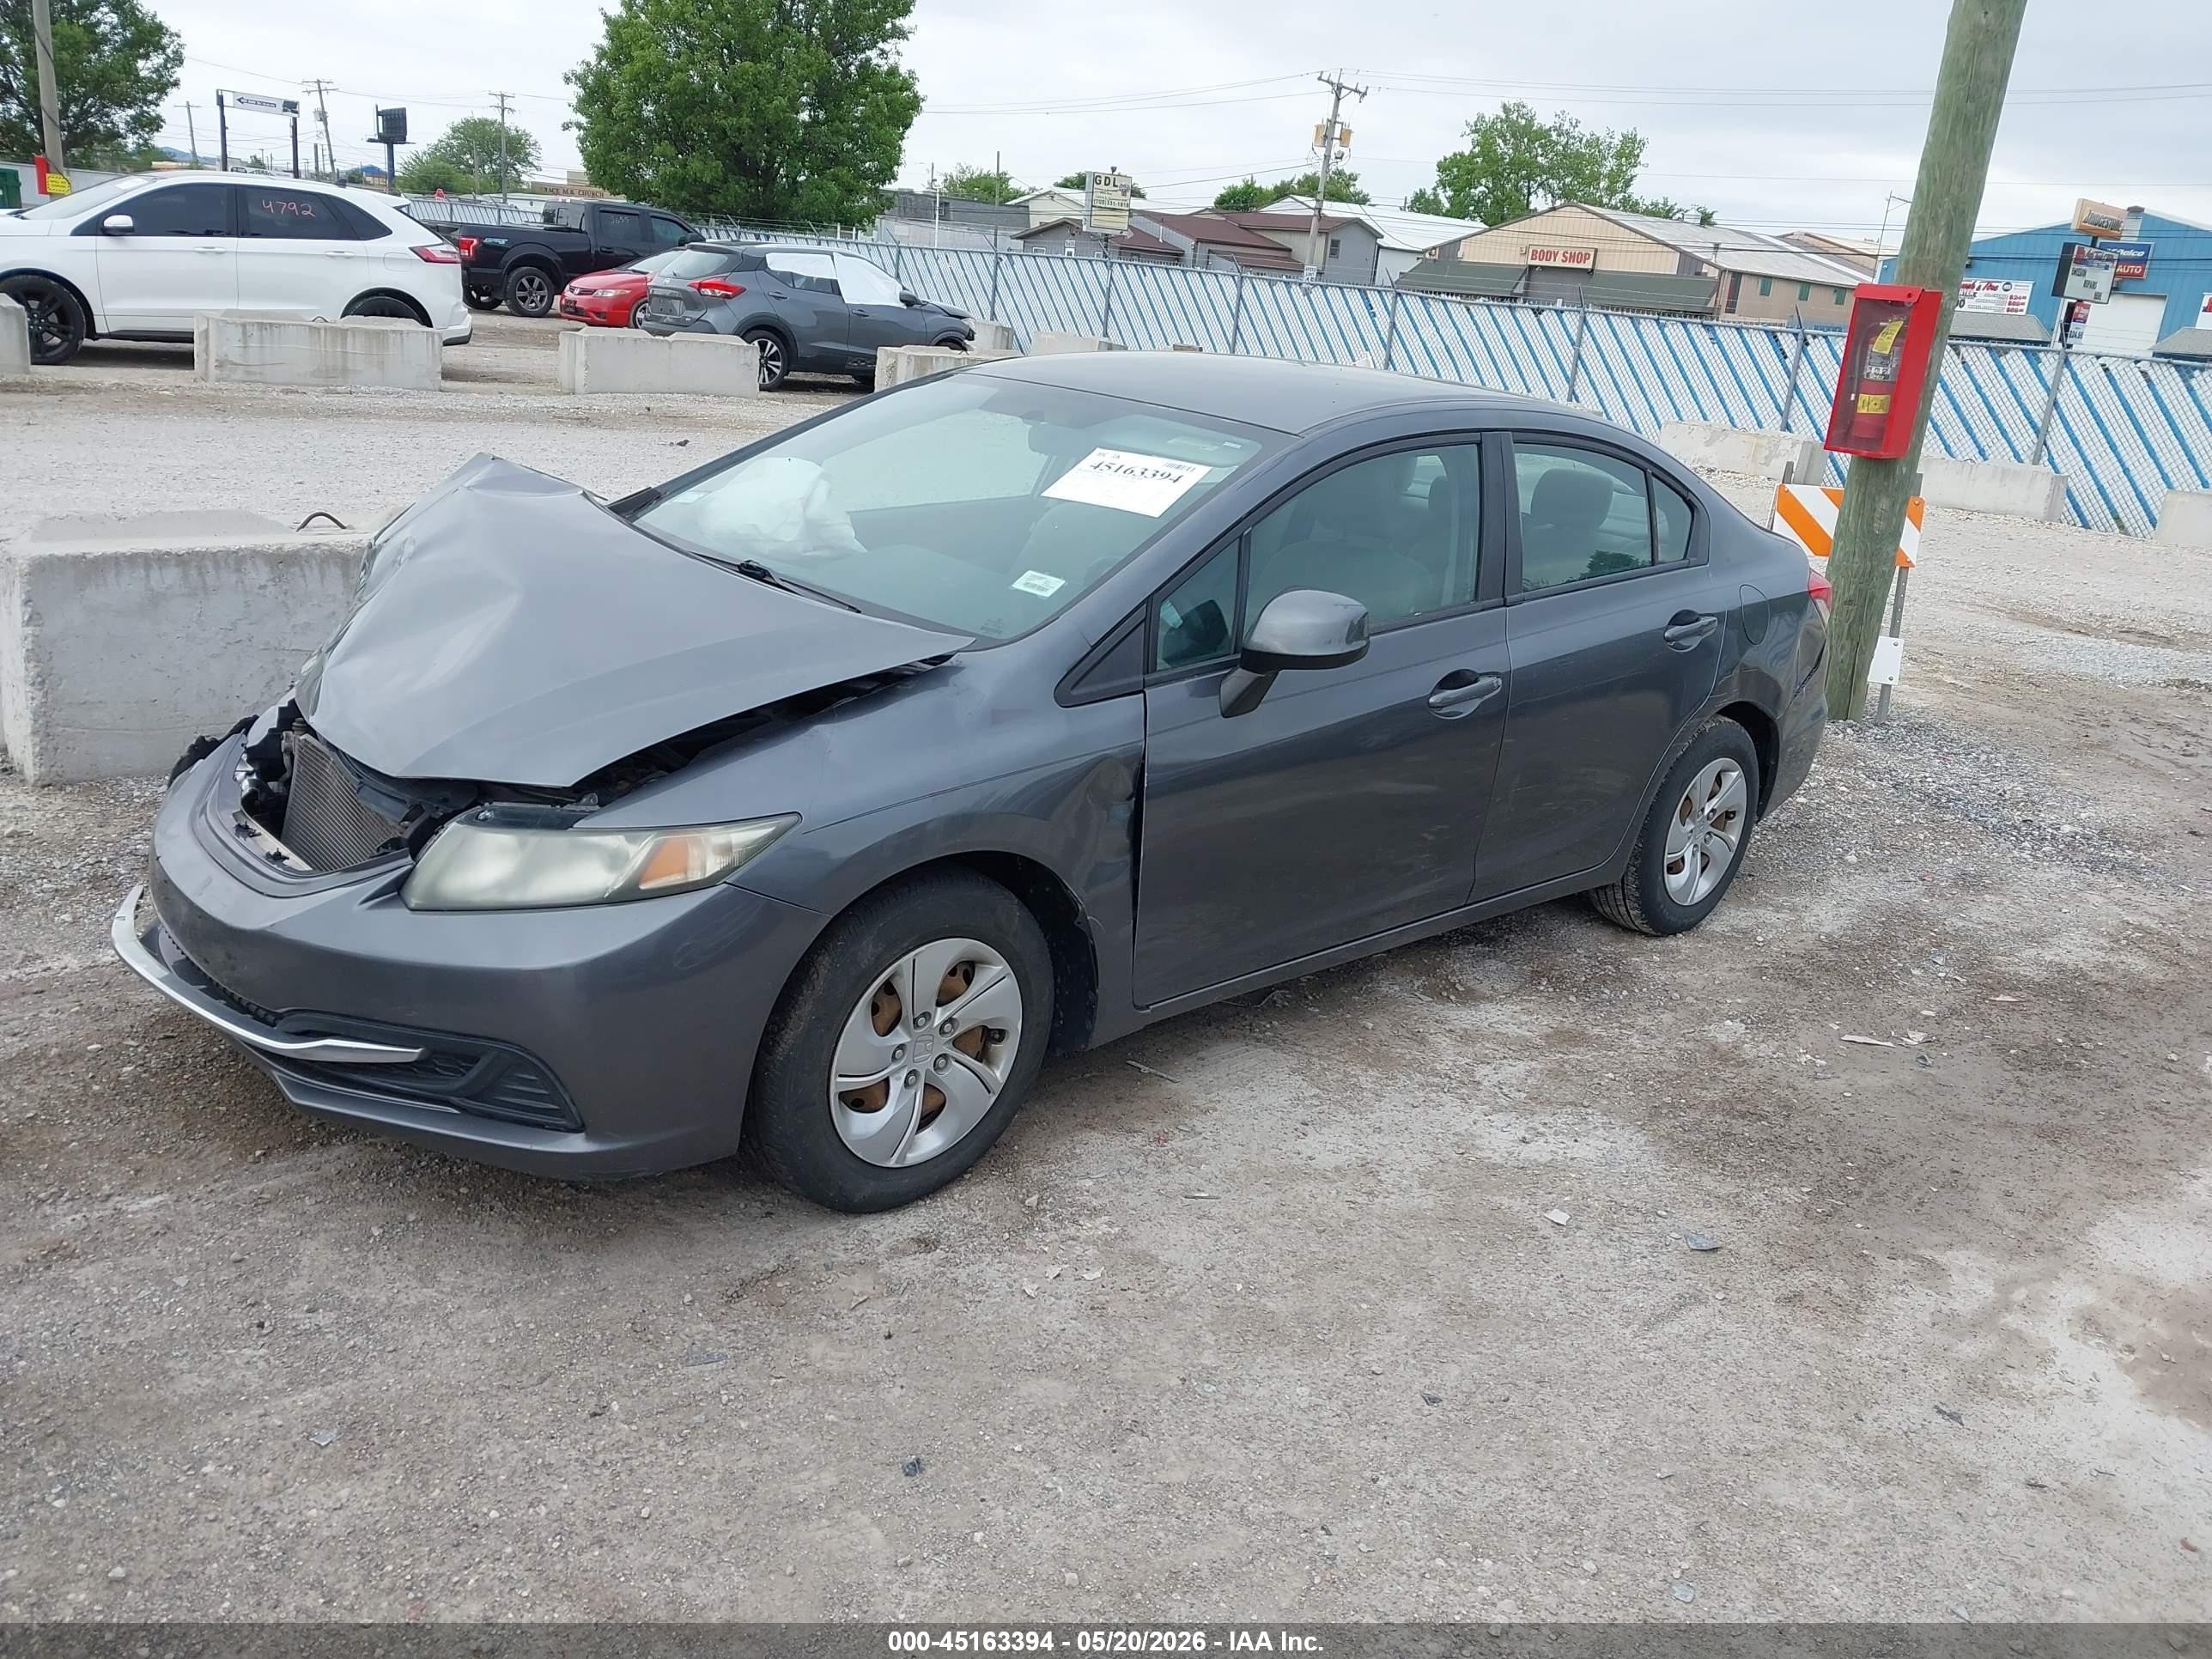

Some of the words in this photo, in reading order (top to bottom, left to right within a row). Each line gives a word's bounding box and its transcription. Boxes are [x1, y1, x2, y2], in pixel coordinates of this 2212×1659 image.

[1095, 175, 1118, 187] GDL
[261, 198, 317, 217] 4792
[1530, 249, 1559, 262] BODY
[1561, 250, 1591, 264] SHOP
[2116, 264, 2142, 274] AUTO
[1090, 460, 1184, 483] 45163394
